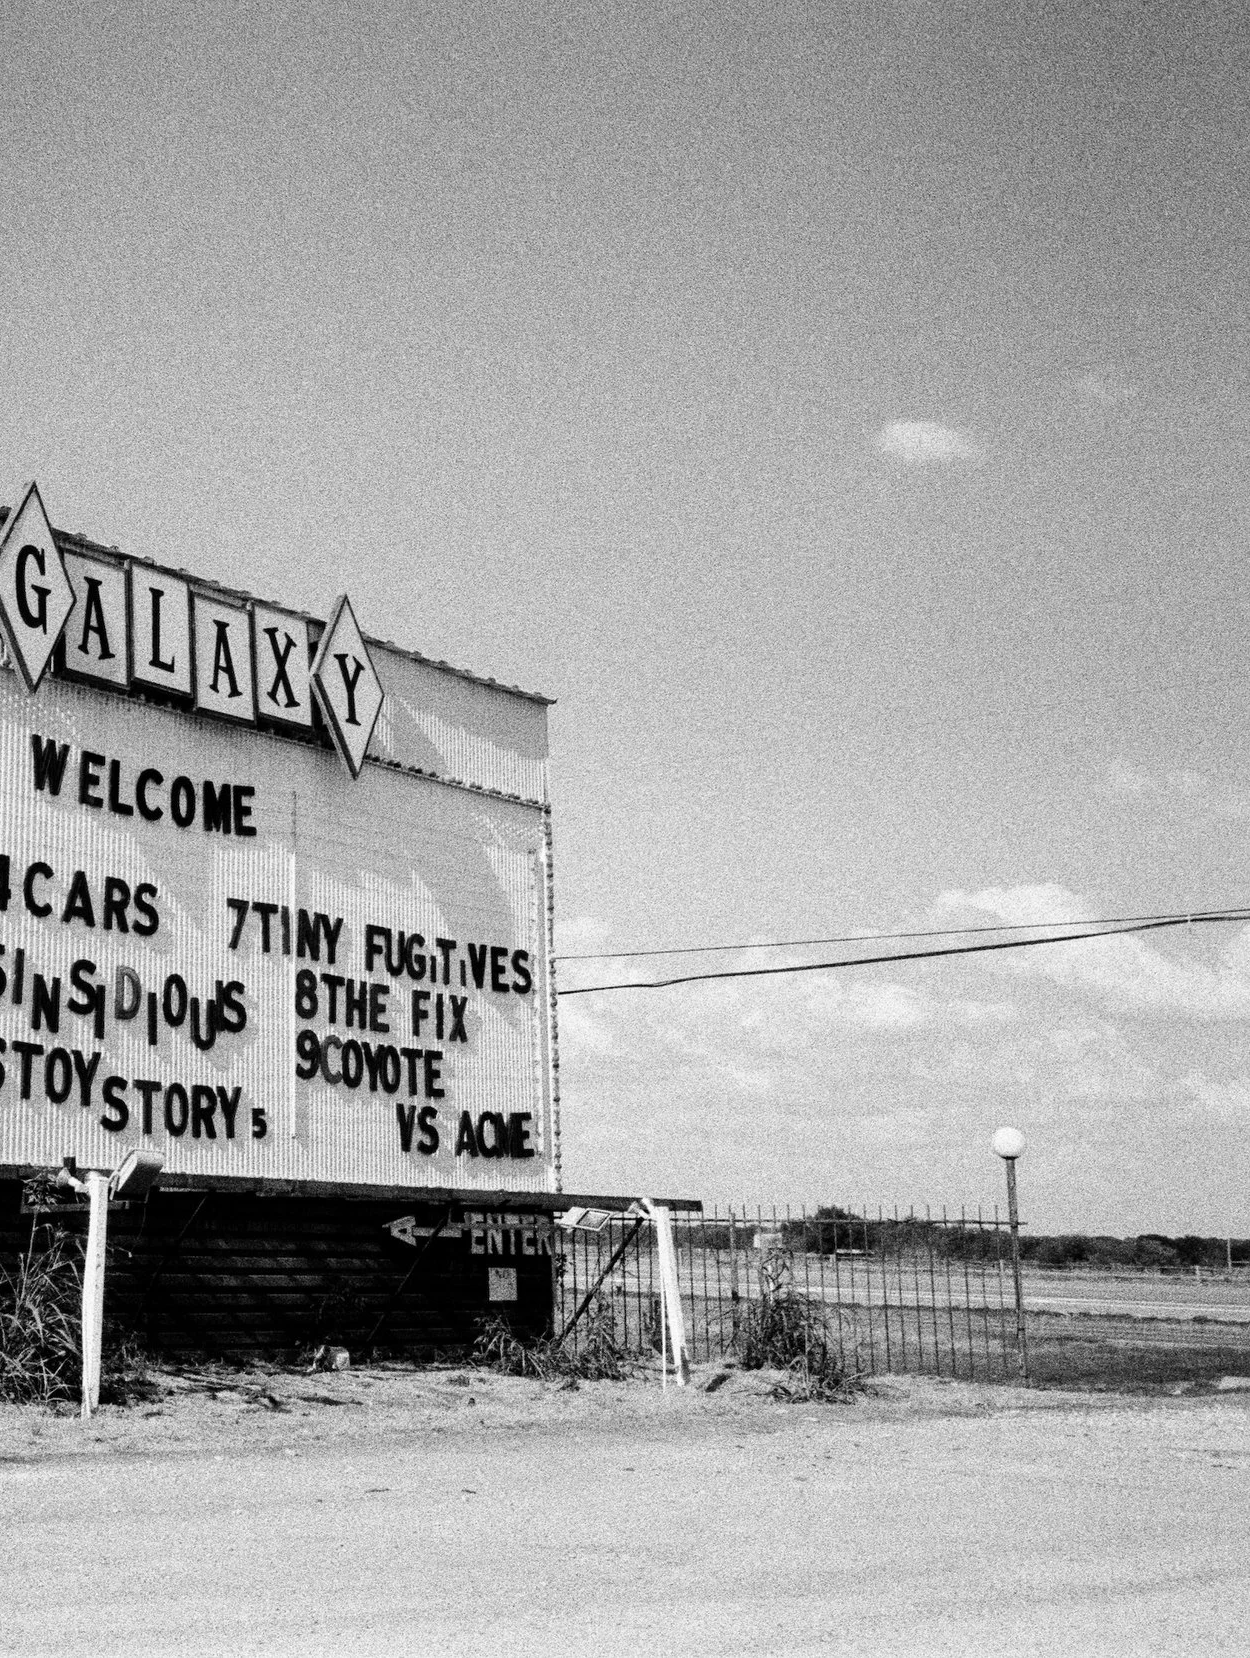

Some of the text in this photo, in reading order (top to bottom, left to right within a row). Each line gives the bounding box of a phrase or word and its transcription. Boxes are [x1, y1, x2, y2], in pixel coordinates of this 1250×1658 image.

[15, 544, 366, 727] GALAXY
[31, 733, 257, 836] WELCOME
[365, 923, 533, 994] FUGITIVES
[412, 989, 468, 1043] FIX
[100, 1075, 242, 1139] STORY
[251, 1107, 268, 1139] 5
[396, 1102, 535, 1158] VS ACME
[470, 1212, 552, 1255] ENTER
